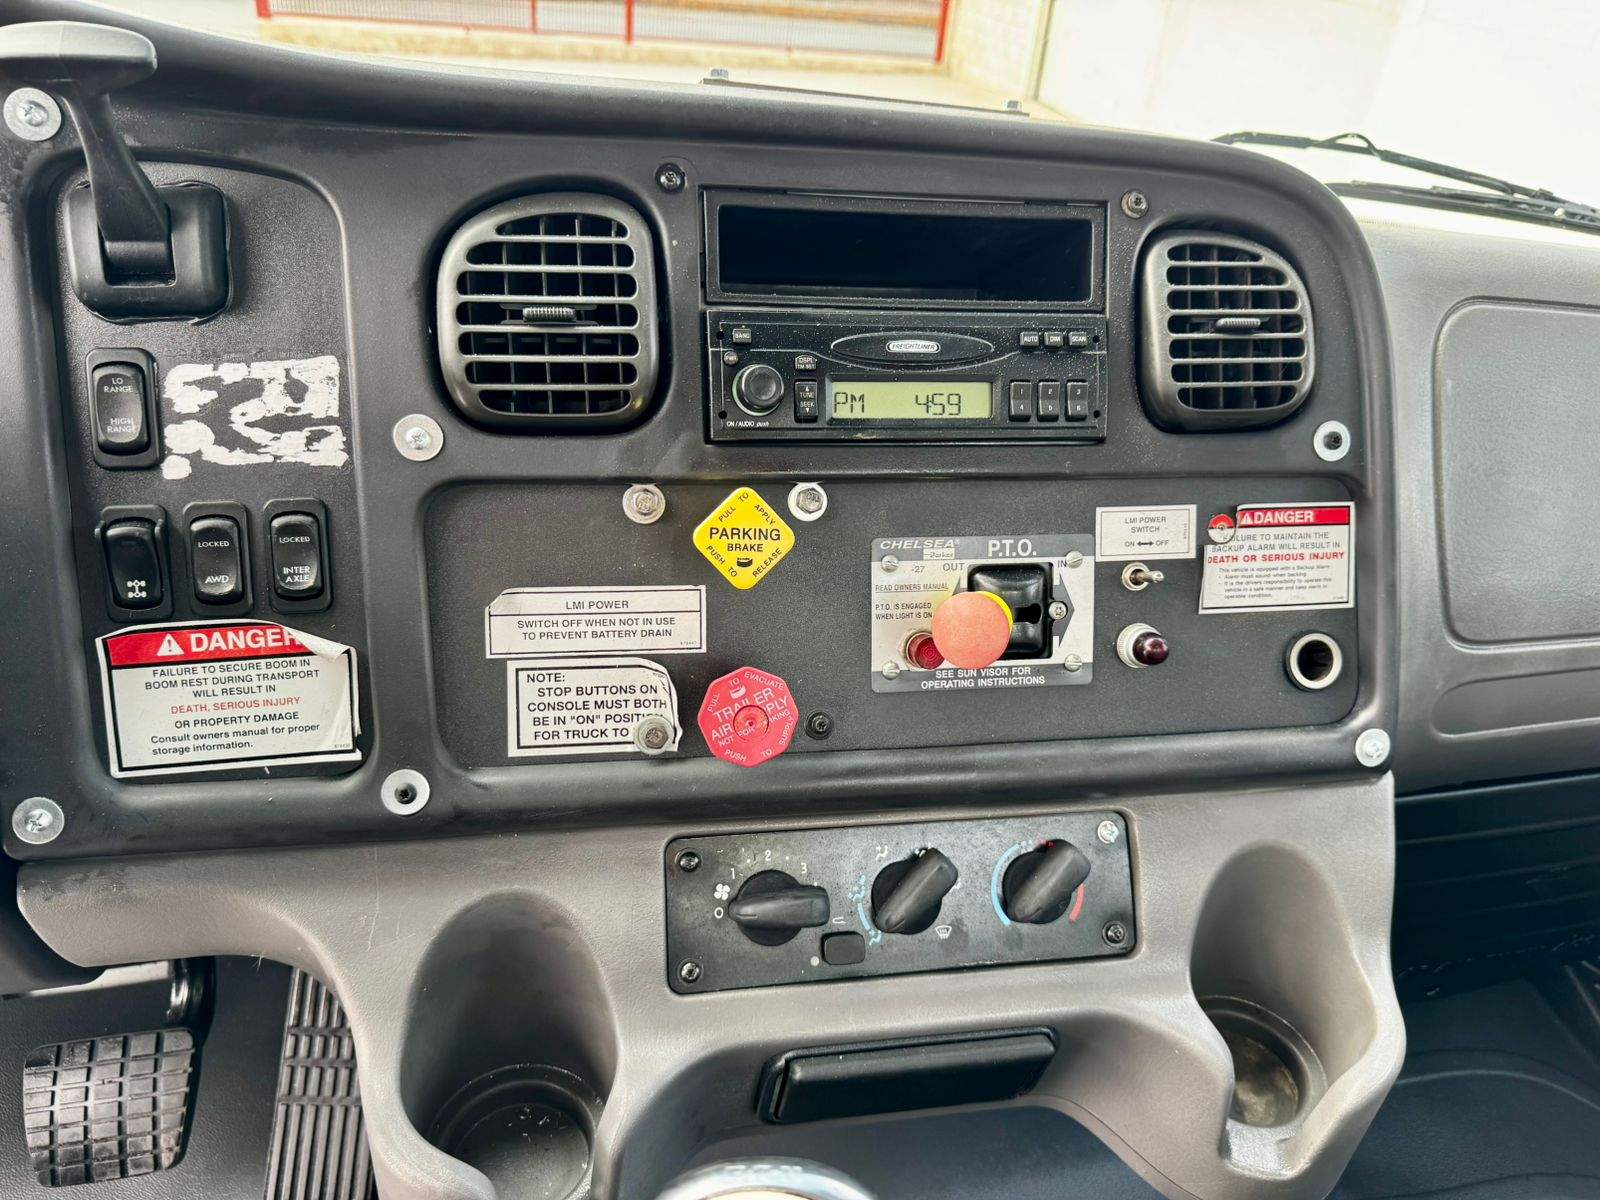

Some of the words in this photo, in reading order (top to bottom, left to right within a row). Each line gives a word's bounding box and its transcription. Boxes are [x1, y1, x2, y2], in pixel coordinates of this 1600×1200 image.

[889, 343, 938, 351] FREIGHTLINER
[103, 384, 134, 393] RANGE
[834, 392, 865, 413] PM
[110, 417, 133, 425] HIGH
[107, 425, 135, 434] RANGE
[718, 507, 736, 522] PULL
[738, 492, 749, 503] TO
[754, 504, 776, 526] APPLY
[1139, 516, 1167, 524] POWER
[1254, 511, 1314, 523] DANGER
[279, 535, 310, 544] LOCKED
[710, 527, 780, 541] PARKING
[1274, 532, 1311, 540] MAINTAIN
[198, 540, 229, 548] LOCKED
[727, 544, 763, 552] BRAKE
[987, 539, 1037, 557] P.T.O.
[706, 545, 725, 564] PUSH
[727, 567, 738, 577] TO
[752, 548, 782, 577] RELEASE
[1262, 553, 1304, 561] SERIOUS
[1310, 551, 1344, 560] INJURY
[942, 563, 965, 572] OUT
[1057, 560, 1067, 568] IN
[282, 566, 310, 574] INTER
[205, 574, 229, 584] AWD
[285, 574, 310, 583] AXLE
[875, 583, 893, 591] READ
[894, 583, 921, 591] OWNERS
[923, 582, 948, 590] MANUAL
[566, 601, 586, 610] LMI
[588, 600, 629, 609] POWER
[517, 620, 559, 629] SWITCH
[562, 619, 584, 628] OFF
[586, 619, 617, 627] WHEN
[619, 618, 639, 626] NOT
[642, 618, 653, 626] IN
[522, 632, 536, 640] TO
[539, 630, 588, 640] PREVENT
[590, 629, 639, 639] BATTERY
[641, 628, 672, 637] DRAIN
[153, 667, 198, 678] FAILURE
[202, 665, 216, 675] TO
[219, 662, 262, 674] SECURE
[265, 660, 297, 670] BOOM
[300, 659, 311, 668] IN
[936, 670, 955, 679] SEE
[957, 669, 977, 678] SUN
[980, 668, 1008, 677] VISOR
[1011, 667, 1031, 676] FOR
[145, 680, 178, 690] BOOM
[181, 677, 209, 688] REST
[212, 675, 253, 686] DURING
[256, 670, 320, 683] TRANSPORT
[527, 673, 566, 683] NOTE:
[729, 678, 739, 686] TO
[744, 672, 785, 690] EVACUATE
[921, 679, 975, 690] OPERATING
[978, 676, 1045, 687] INSTRUCTIONS
[193, 688, 218, 698] WILL
[221, 685, 262, 697] RESULT
[266, 684, 276, 693] IN
[537, 686, 572, 697] STOP
[575, 685, 636, 696] BUTTONS
[640, 684, 658, 694] ON
[171, 703, 211, 715] DEATH,
[213, 700, 260, 712] SERIOUS
[263, 697, 301, 709] INJURY
[527, 700, 591, 712] CONSOLE
[594, 699, 631, 710] MUST
[634, 699, 667, 709] BOTH
[174, 719, 190, 729] OR
[193, 715, 251, 728] PROPERTY
[253, 712, 299, 723] DAMAGE
[533, 716, 550, 726] BE
[554, 716, 566, 726] IN
[570, 714, 601, 725] "ON"
[151, 733, 190, 744] Consult
[193, 731, 229, 741] owners
[232, 727, 269, 738] manual
[272, 727, 286, 735] for
[288, 723, 320, 737] proper
[534, 729, 560, 740] FOR
[564, 728, 609, 739] TRUCK
[612, 727, 629, 738] TO
[711, 723, 733, 741] AIR
[718, 736, 733, 747] NOT
[152, 745, 191, 757] storage
[193, 741, 253, 752] information.
[725, 749, 747, 762] PUSH
[761, 749, 772, 757] TO
[764, 850, 771, 861] 2
[730, 868, 735, 879] 1
[800, 863, 807, 873] 3
